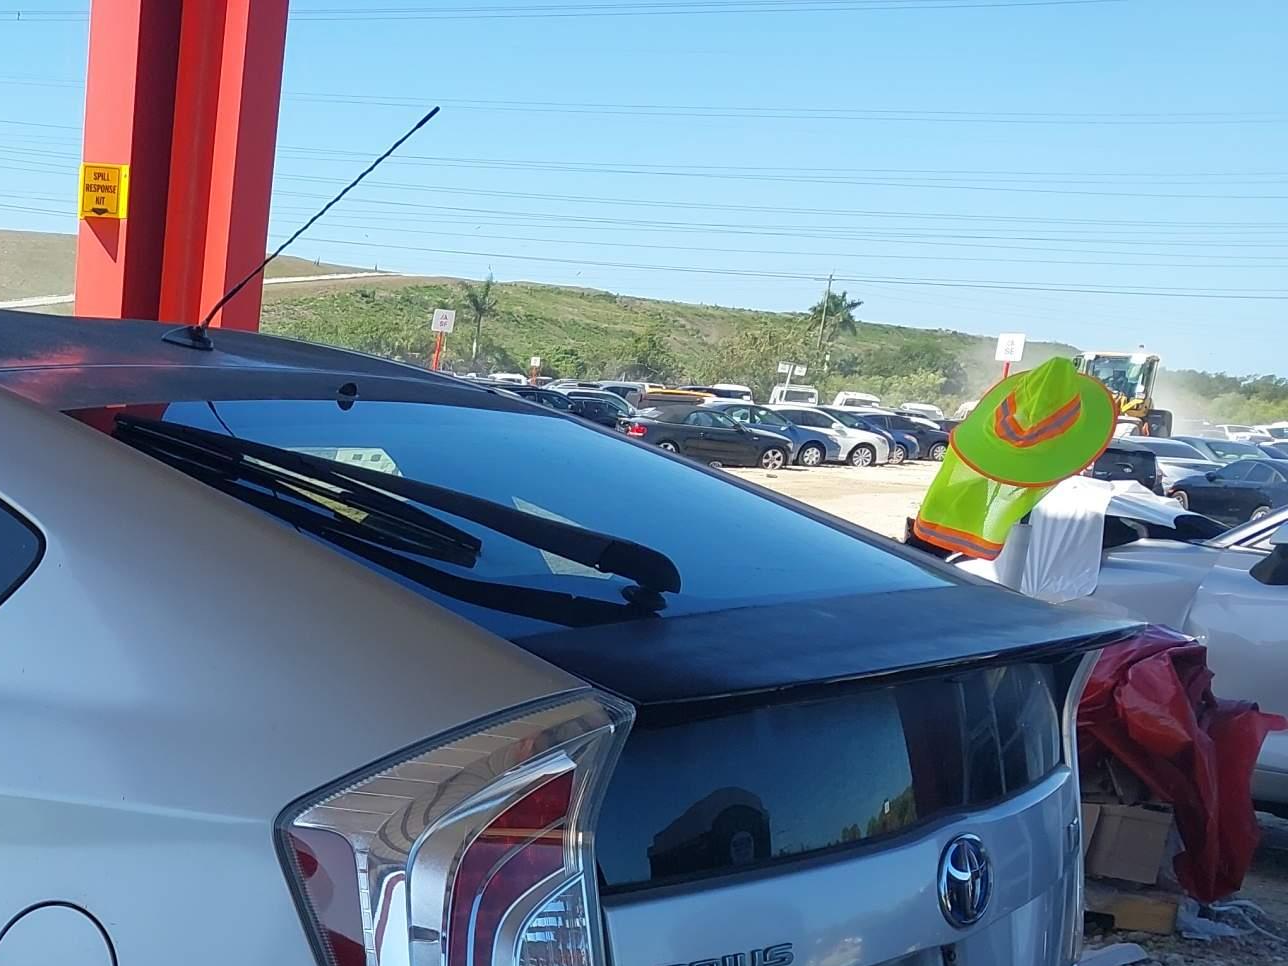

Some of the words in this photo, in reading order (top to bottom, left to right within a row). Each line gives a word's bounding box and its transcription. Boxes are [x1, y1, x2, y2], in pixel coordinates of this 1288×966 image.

[93, 172, 110, 181] SPILL
[85, 183, 117, 194] RESPONSE
[95, 195, 105, 205] KIT
